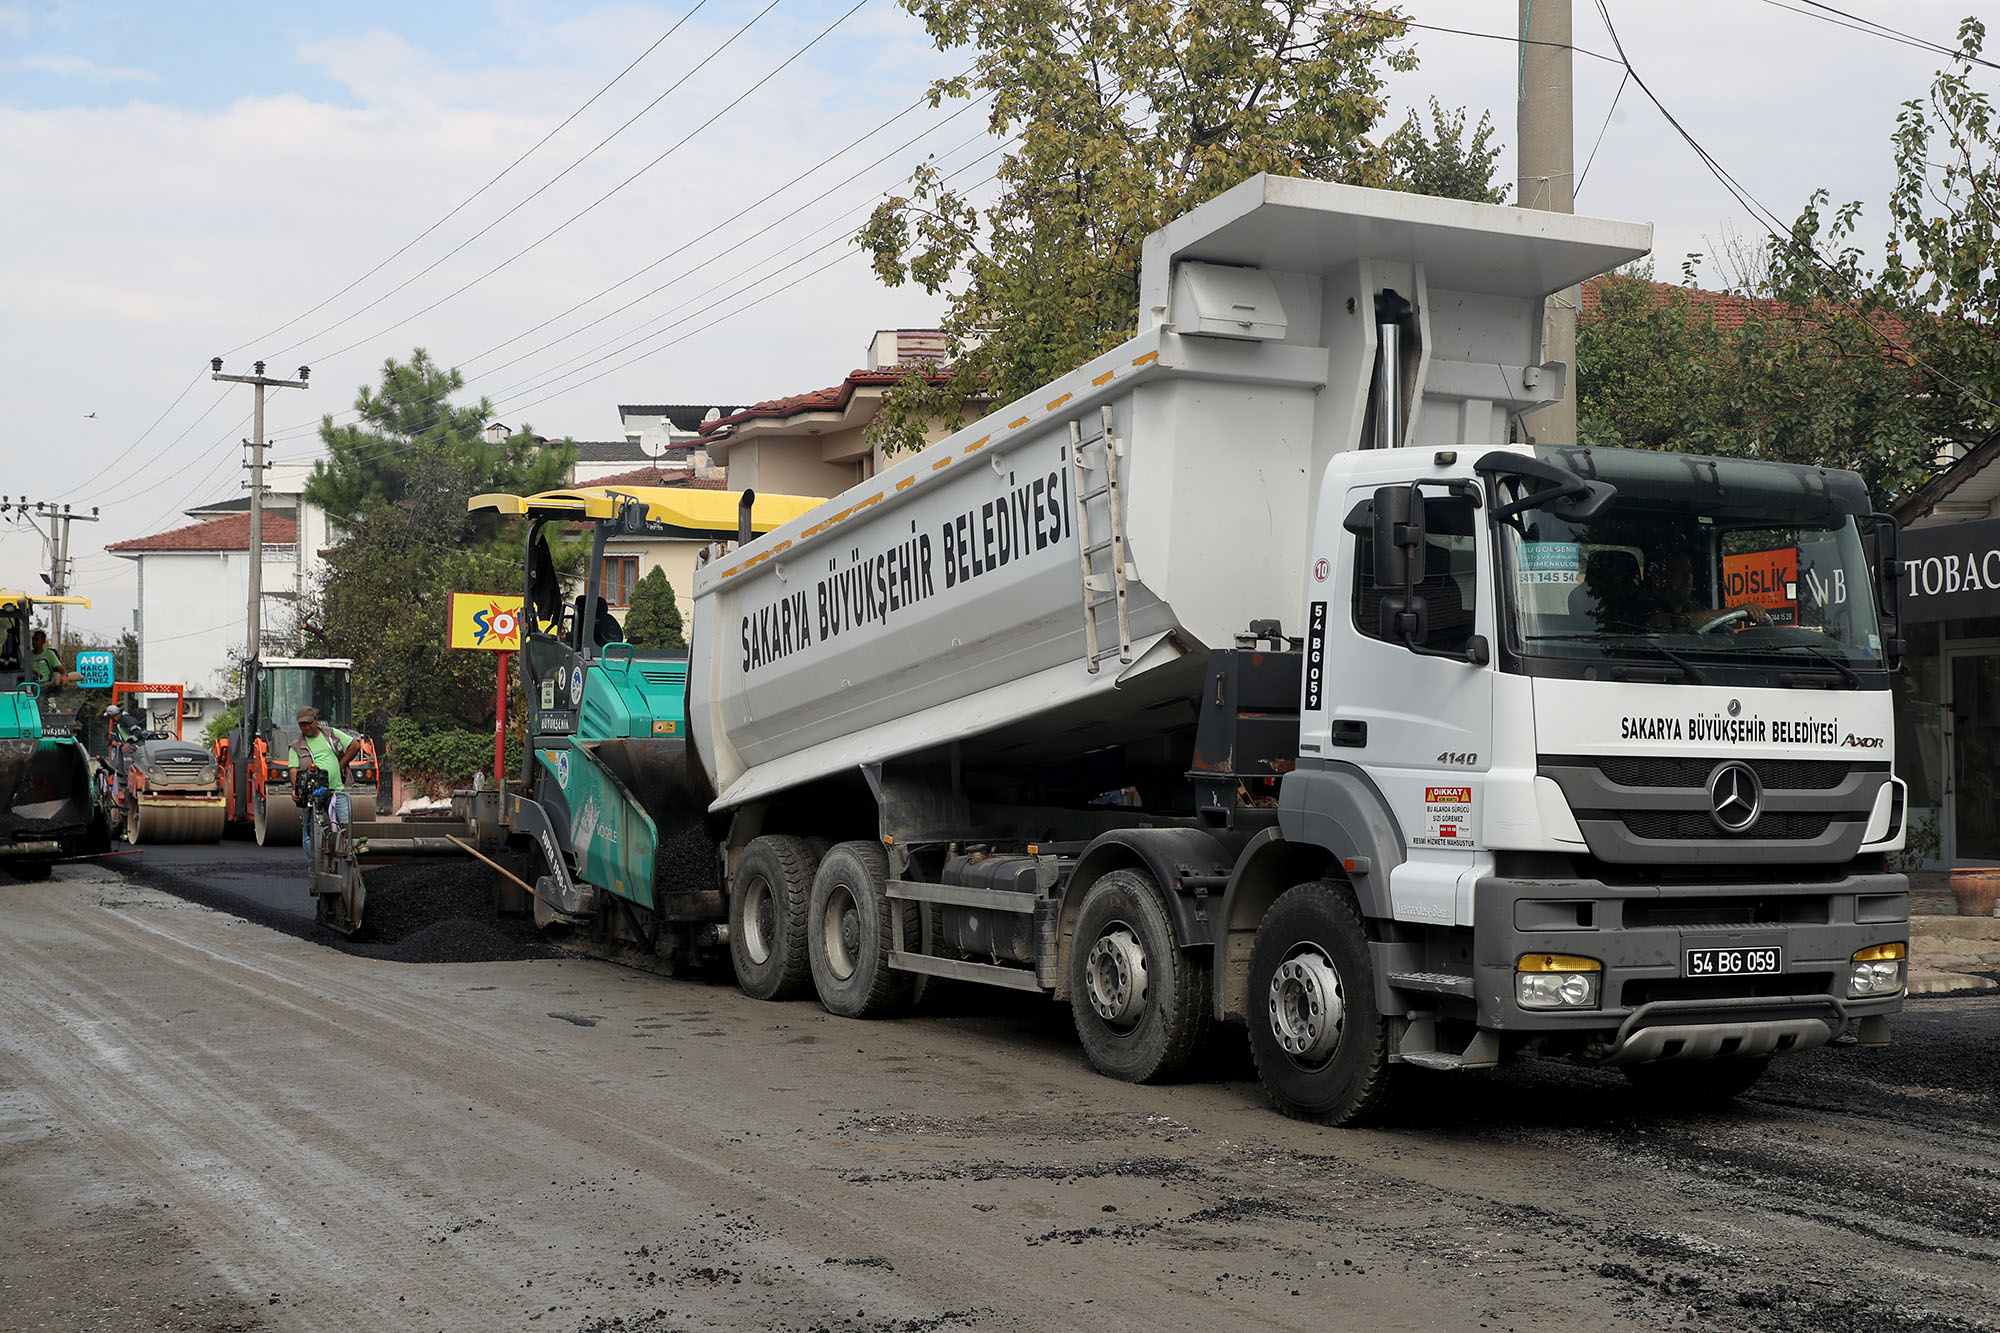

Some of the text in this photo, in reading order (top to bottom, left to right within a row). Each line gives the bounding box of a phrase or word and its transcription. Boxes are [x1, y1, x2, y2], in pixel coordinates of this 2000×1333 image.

[740, 446, 1071, 673] SAKARYA BÜYÜKŞEHİR BELEDİYESİ
[1316, 562, 1328, 579] 10
[1537, 572, 1560, 582] 145
[1562, 572, 1575, 582] 54
[473, 608, 522, 645] ŞO
[1309, 605, 1323, 707] 54 BG 059
[1621, 713, 1839, 745] SAKARYA BÜYÜKŞEHİR BELEDİYESİ
[1437, 752, 1478, 765] 4140
[1693, 950, 1775, 973] 54 BG 059
